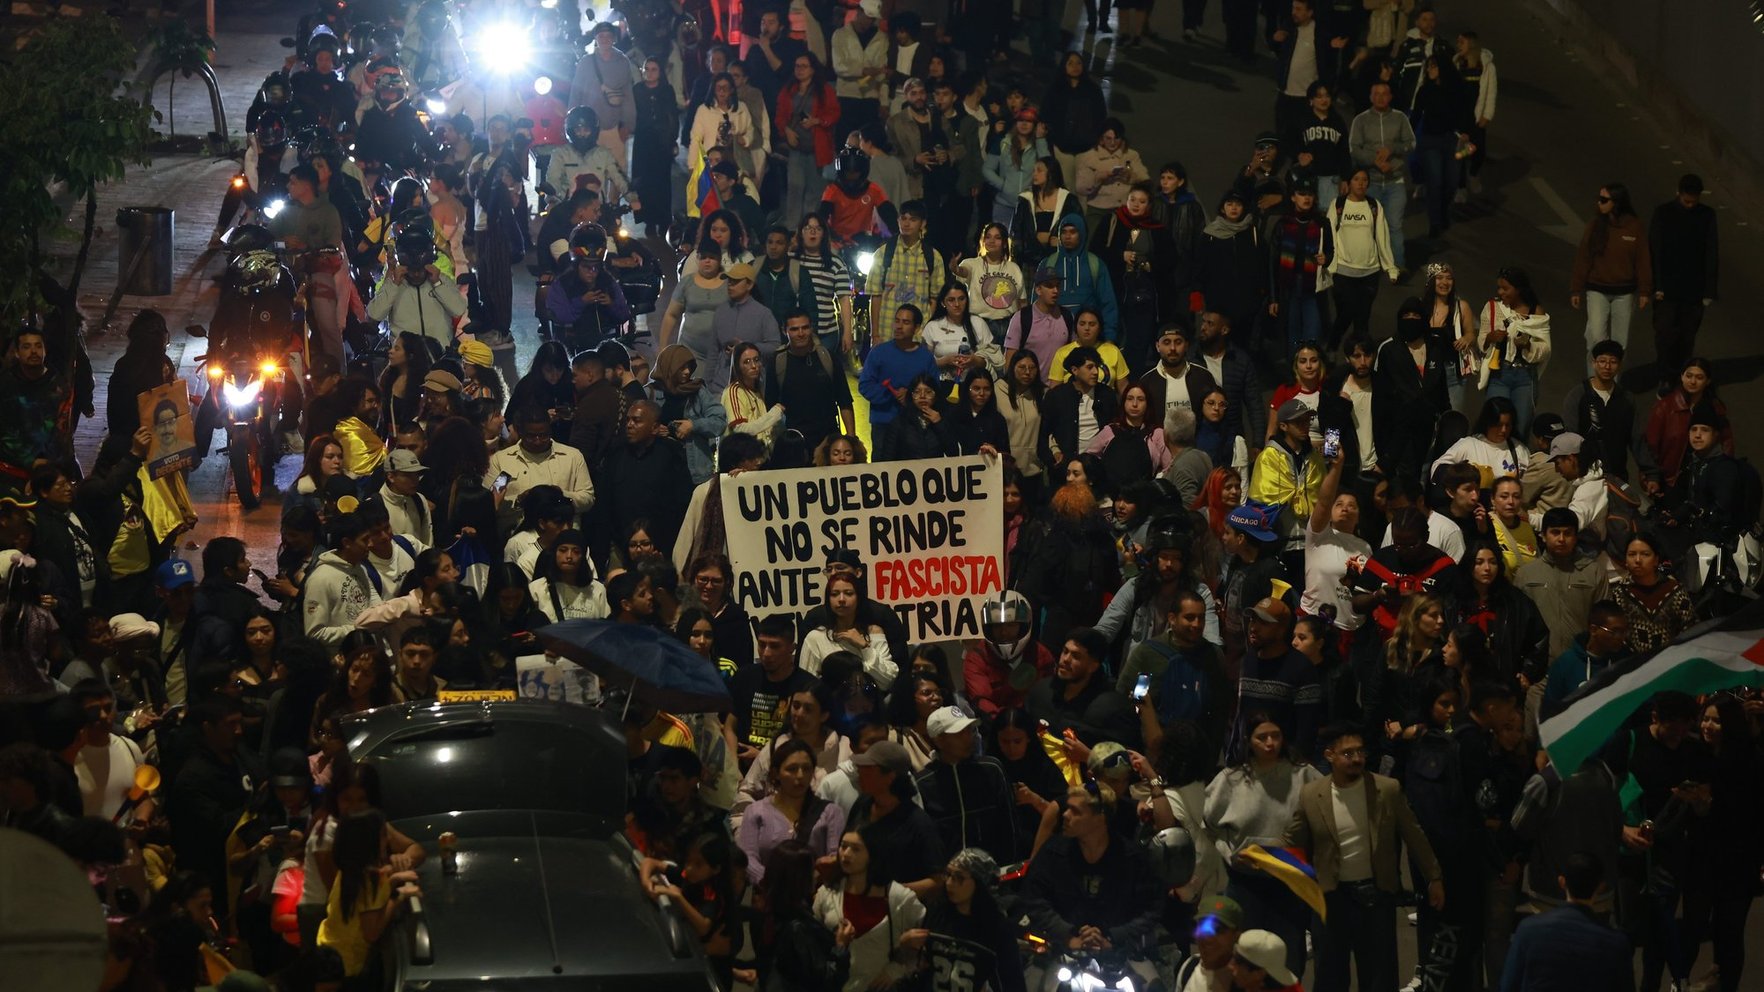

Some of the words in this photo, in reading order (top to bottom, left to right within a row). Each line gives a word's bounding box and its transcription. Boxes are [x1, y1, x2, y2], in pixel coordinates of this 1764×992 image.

[164, 453, 180, 465] VOTO
[738, 482, 789, 521] UN
[797, 468, 918, 518] PUEBLO
[923, 465, 988, 503] QUE
[765, 521, 812, 563] NO
[821, 518, 859, 555] SE
[870, 510, 966, 555] RINDE
[1230, 514, 1258, 526] CHICAGO
[739, 567, 821, 608] ANTE
[874, 556, 1001, 600] FASCISTA
[932, 955, 976, 992] 26
